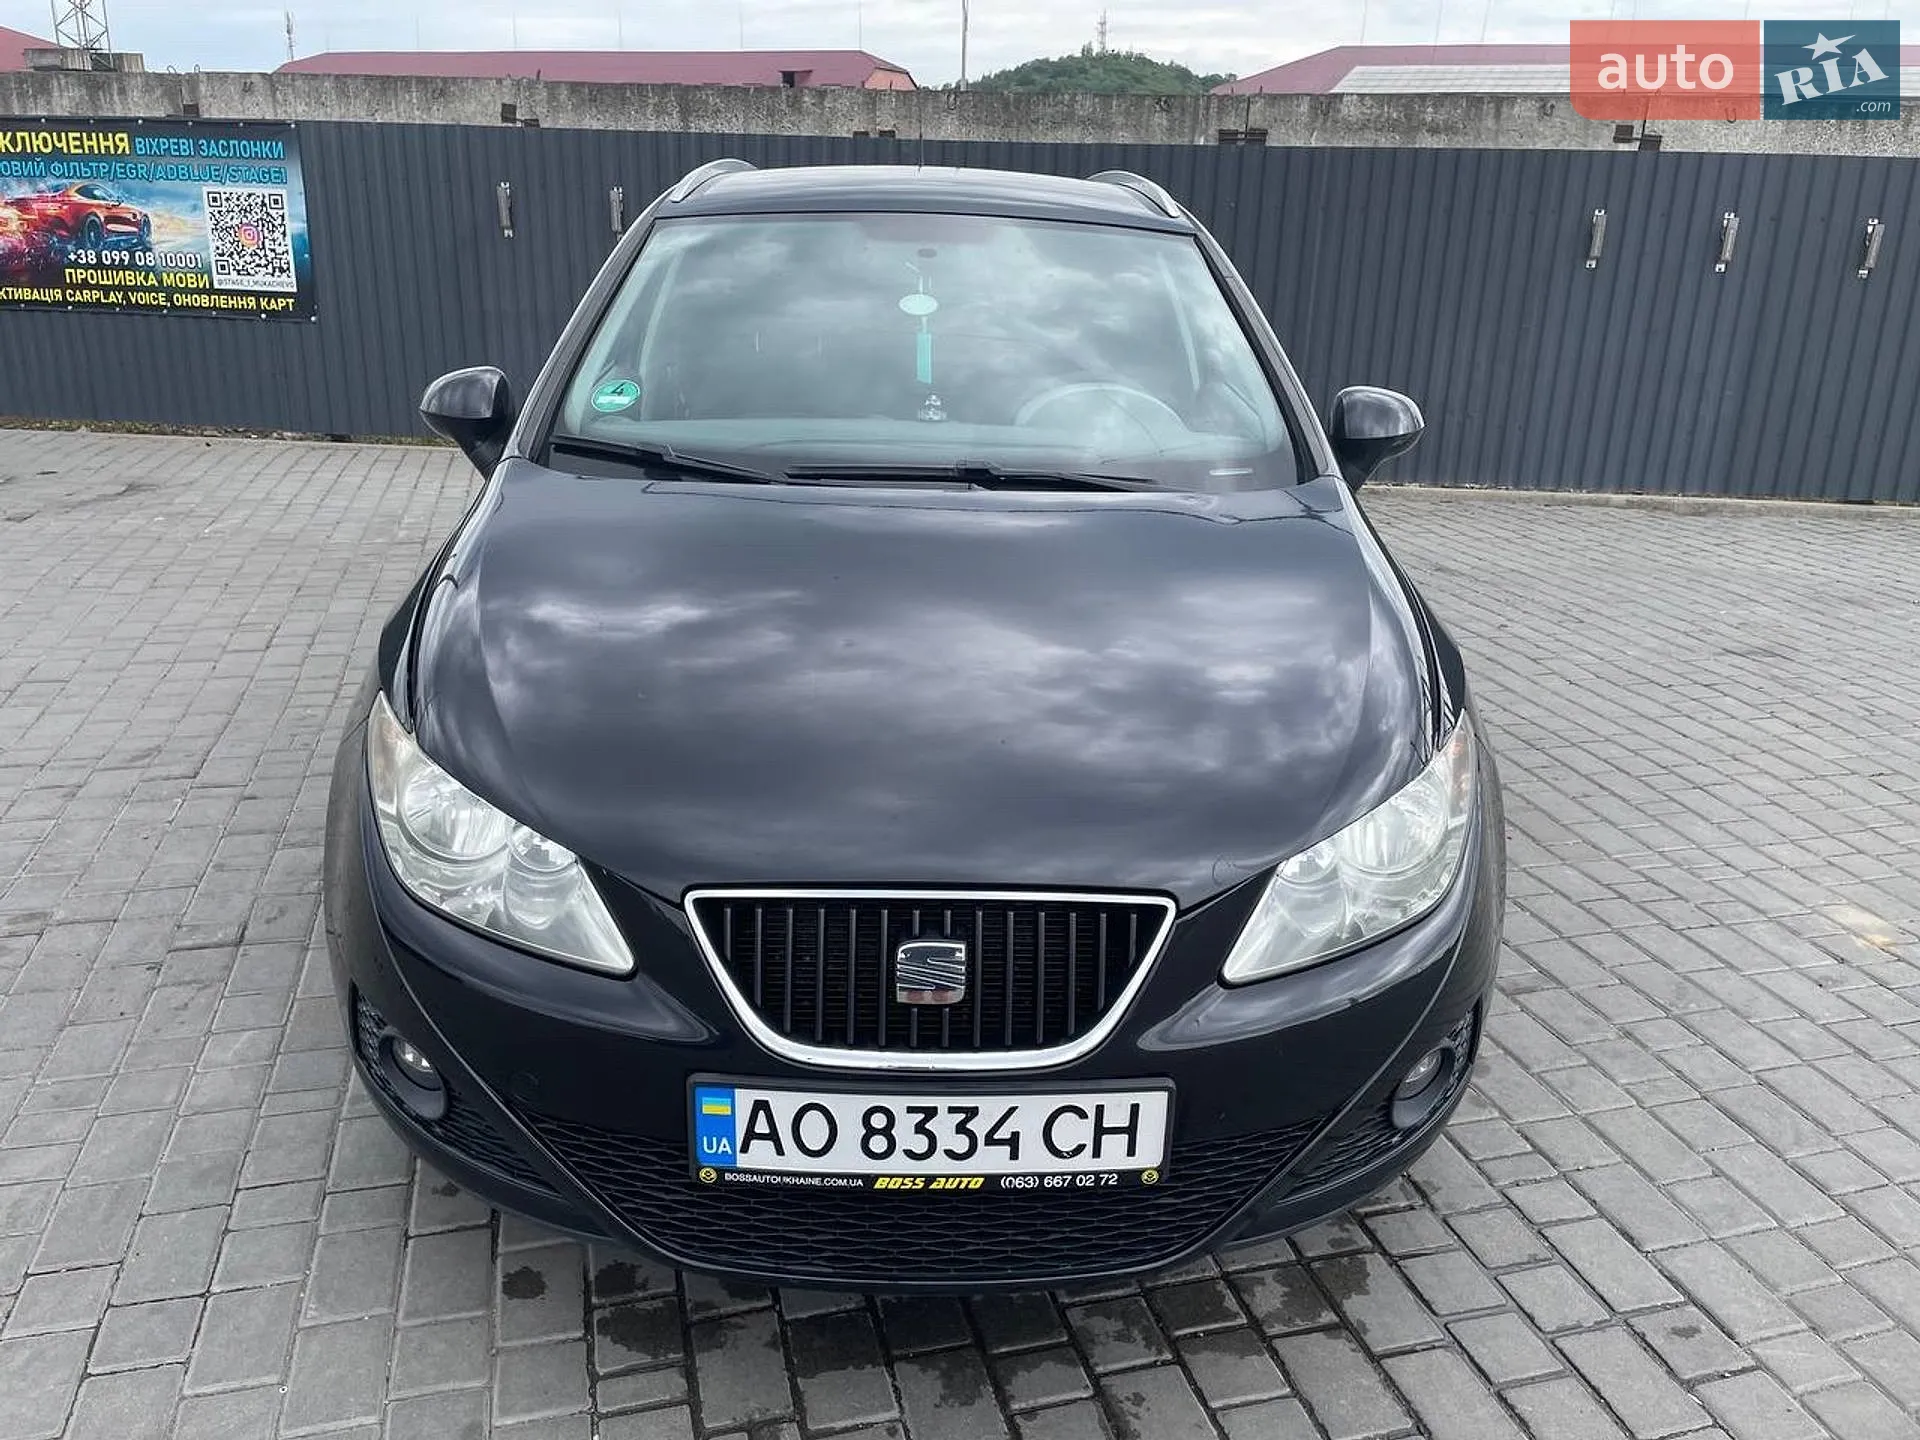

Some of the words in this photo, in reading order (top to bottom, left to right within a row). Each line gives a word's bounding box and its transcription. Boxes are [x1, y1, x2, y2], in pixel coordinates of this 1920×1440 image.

[135, 137, 194, 156] ВІХРЕВІ
[199, 139, 285, 159] ЗАСЛОНКИ
[68, 249, 97, 264] +38
[102, 250, 129, 265] 099
[135, 252, 155, 266] 08
[160, 252, 203, 268] 10001
[65, 268, 158, 287] ПРОШИВКА
[162, 271, 210, 290] МОВИ
[0, 287, 63, 303] КТИВАЦІЯ
[66, 289, 126, 305] CARPLAY,
[127, 292, 170, 307] VOICE,
[173, 294, 257, 310] ОНОВЛЕННЯ
[260, 297, 295, 311] КАРТ
[611, 382, 626, 396] 4
[739, 1099, 839, 1158] AO
[861, 1104, 1021, 1161] 8334
[1041, 1102, 1141, 1159] CH
[703, 1135, 733, 1156] UA
[873, 1176, 926, 1190] BOSS
[928, 1176, 986, 1190] AUTO
[1000, 1174, 1039, 1190] (063)
[1043, 1174, 1073, 1188] 667
[1075, 1174, 1096, 1187] 02
[1099, 1173, 1119, 1186] 72
